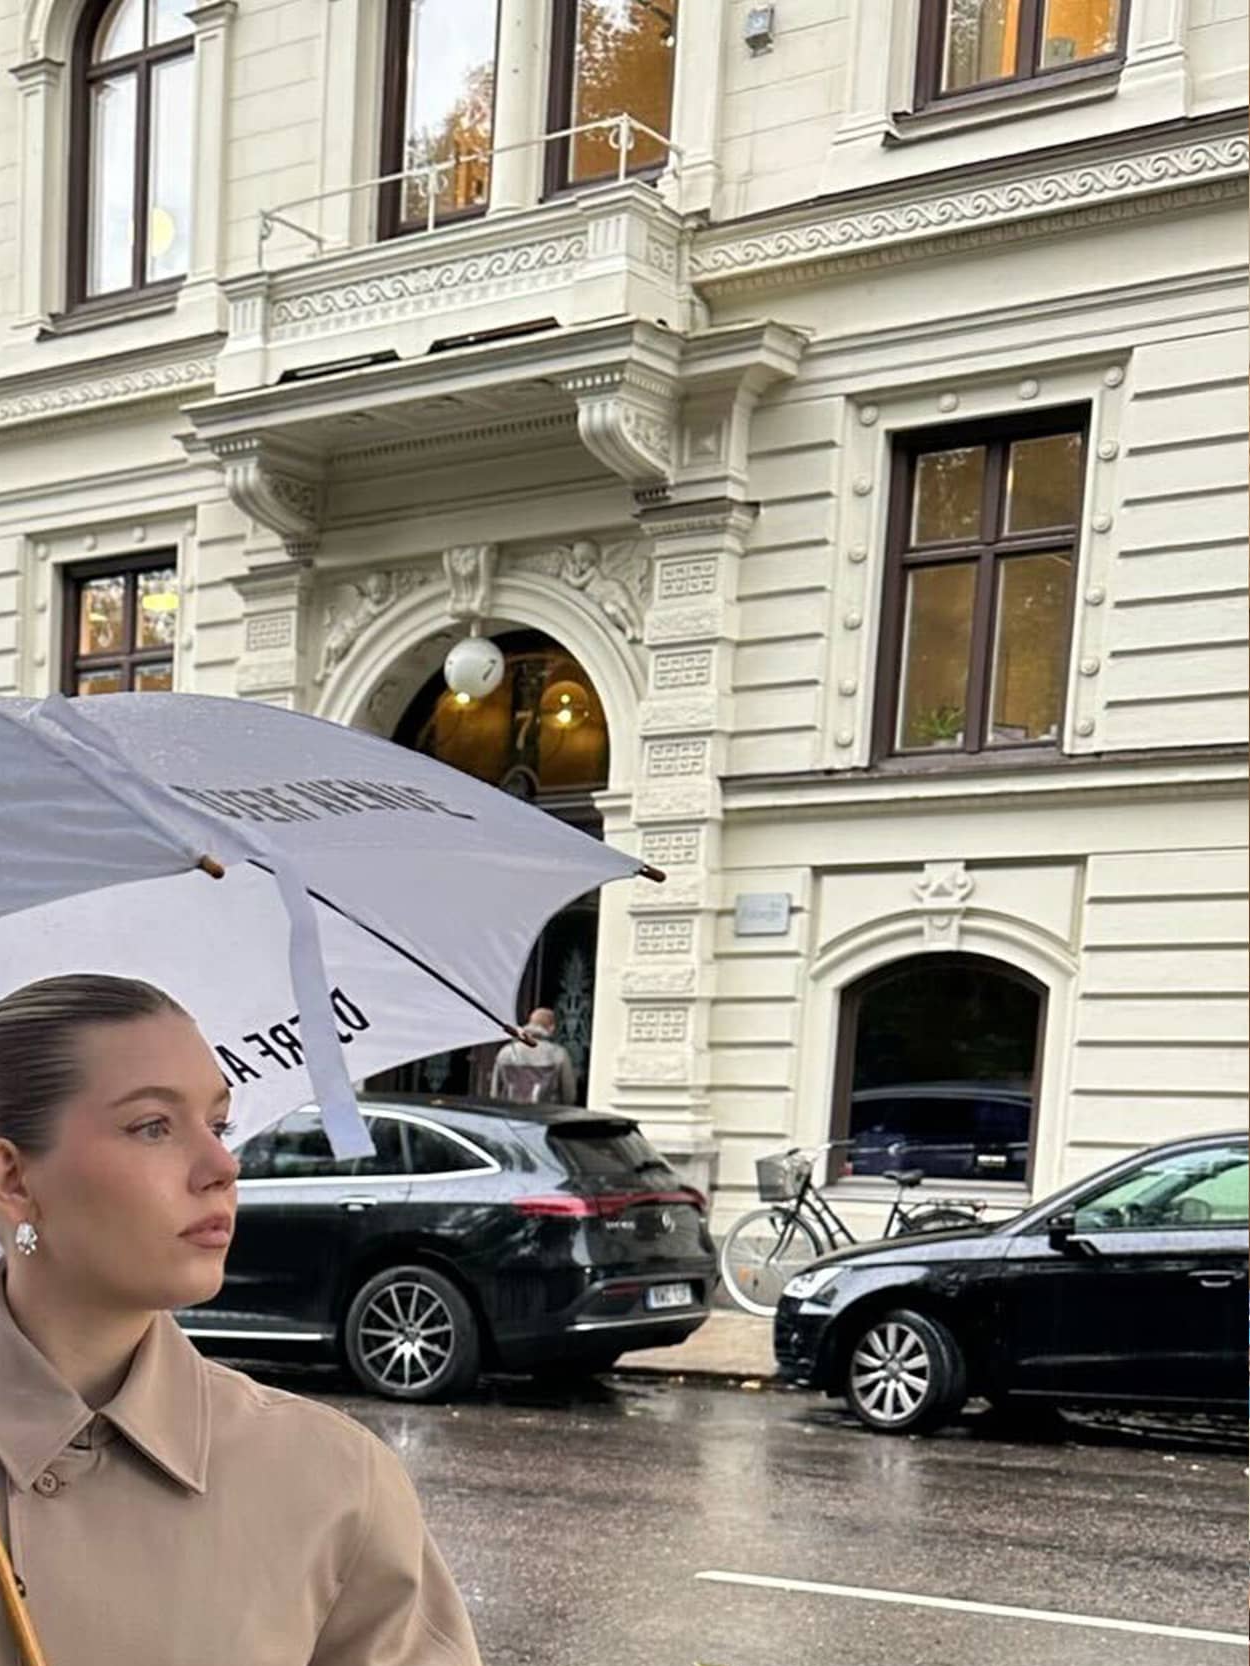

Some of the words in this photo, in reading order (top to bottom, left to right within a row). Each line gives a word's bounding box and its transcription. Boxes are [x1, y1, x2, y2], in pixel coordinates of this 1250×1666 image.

[482, 658, 498, 682] 7
[515, 710, 533, 750] 7
[285, 778, 477, 821] AVENUE
